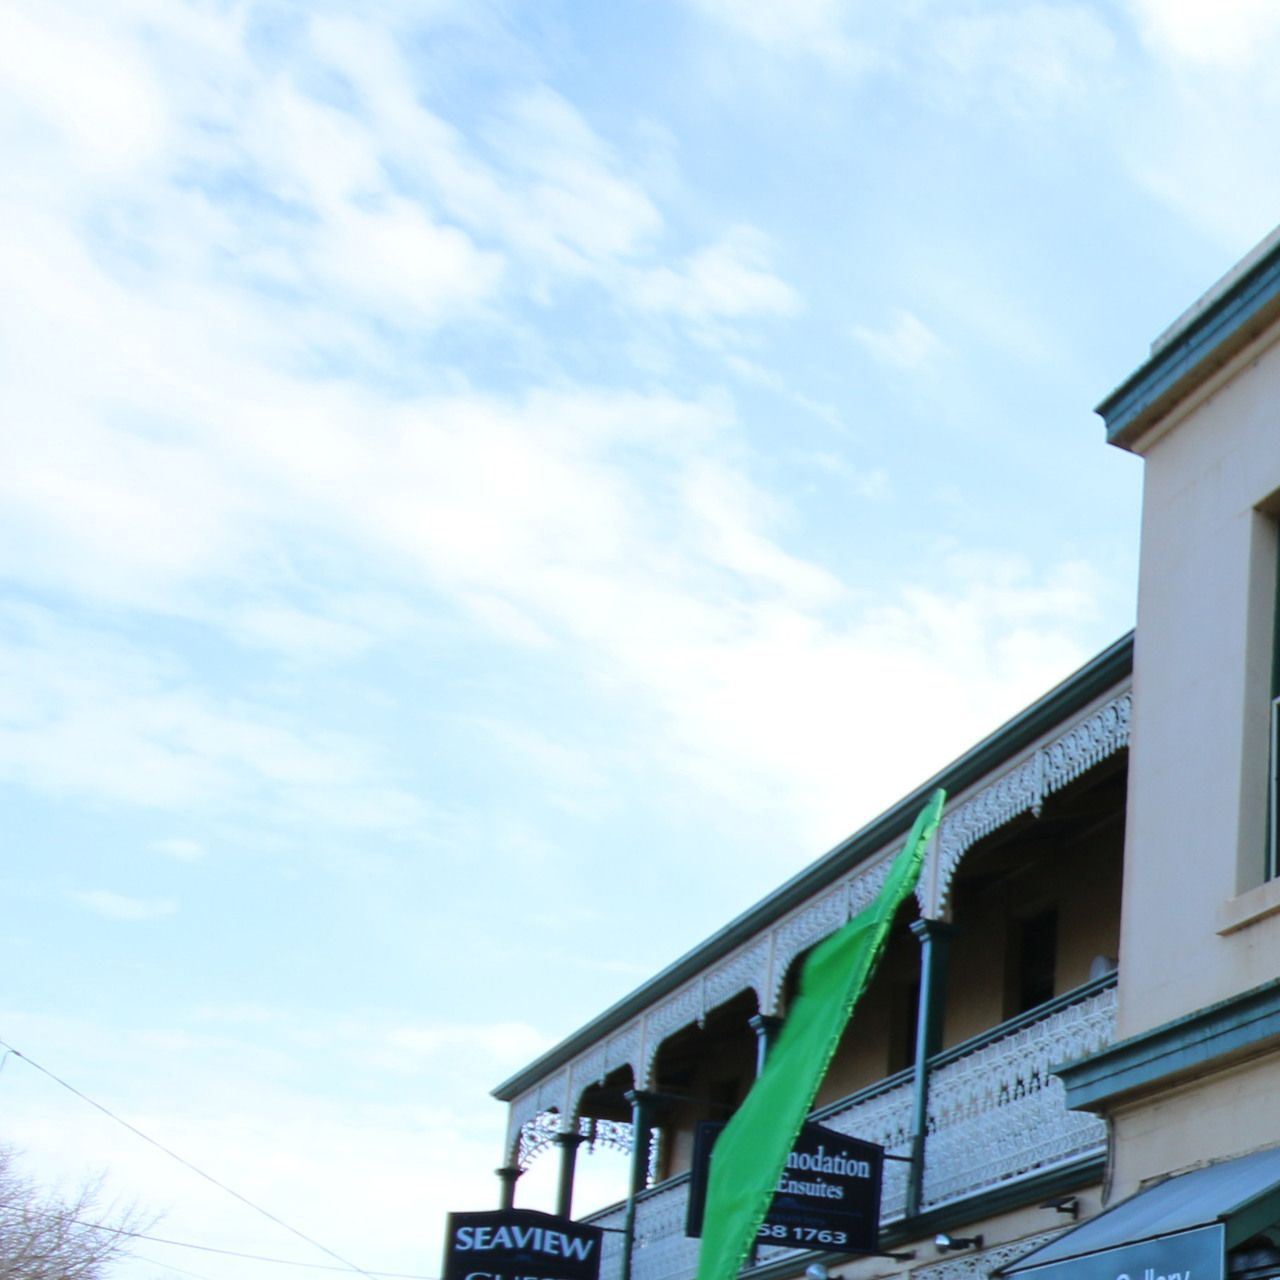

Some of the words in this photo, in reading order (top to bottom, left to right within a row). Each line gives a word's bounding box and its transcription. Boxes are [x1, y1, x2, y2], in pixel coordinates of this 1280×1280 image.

[775, 1173, 844, 1200] Ensuites
[455, 1225, 594, 1262] SEAVIEW
[793, 1227, 848, 1245] 1763
